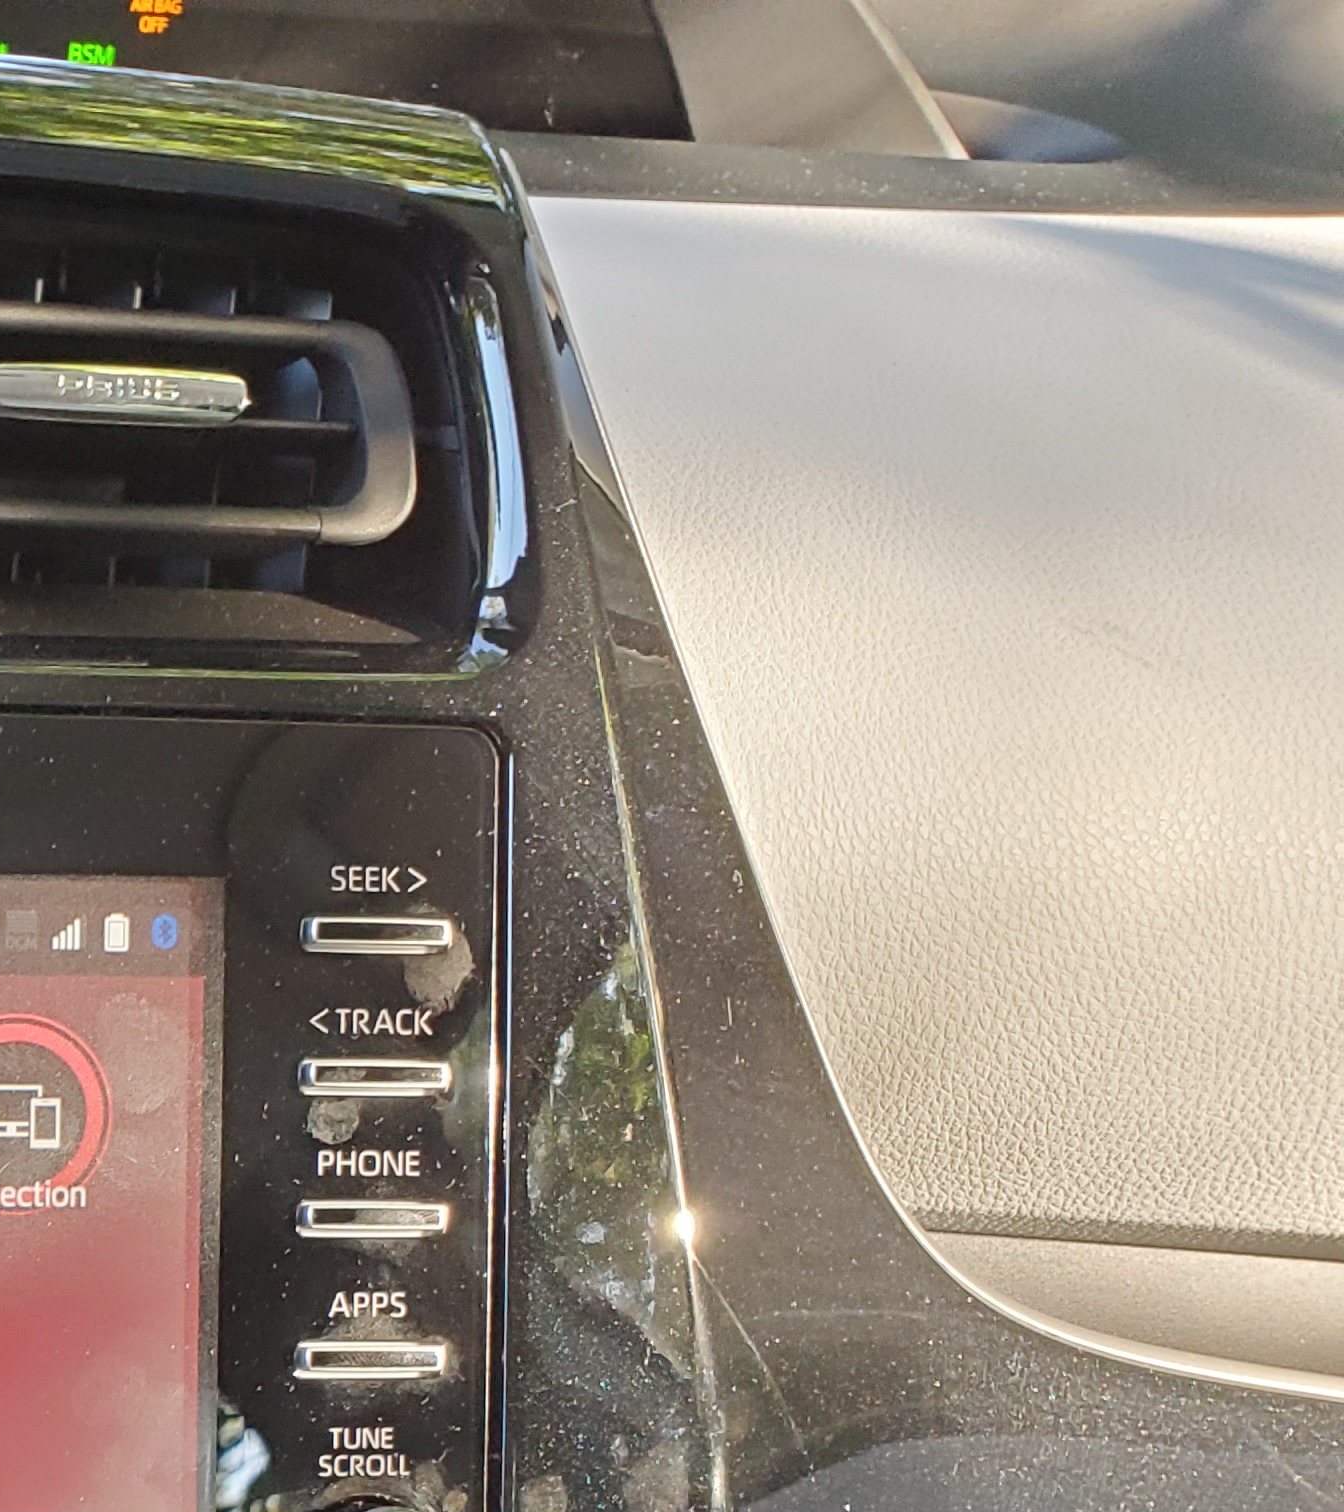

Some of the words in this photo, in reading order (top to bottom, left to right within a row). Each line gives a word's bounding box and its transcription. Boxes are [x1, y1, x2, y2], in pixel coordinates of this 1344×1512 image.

[138, 15, 170, 33] OFF
[68, 42, 116, 66] BSM
[330, 865, 401, 893] SEEK
[334, 1008, 433, 1036] TRACK
[317, 1150, 421, 1177] PHONE
[328, 1291, 408, 1318] APPS
[329, 1427, 394, 1450] TUNE
[318, 1453, 410, 1478] SCROLL
